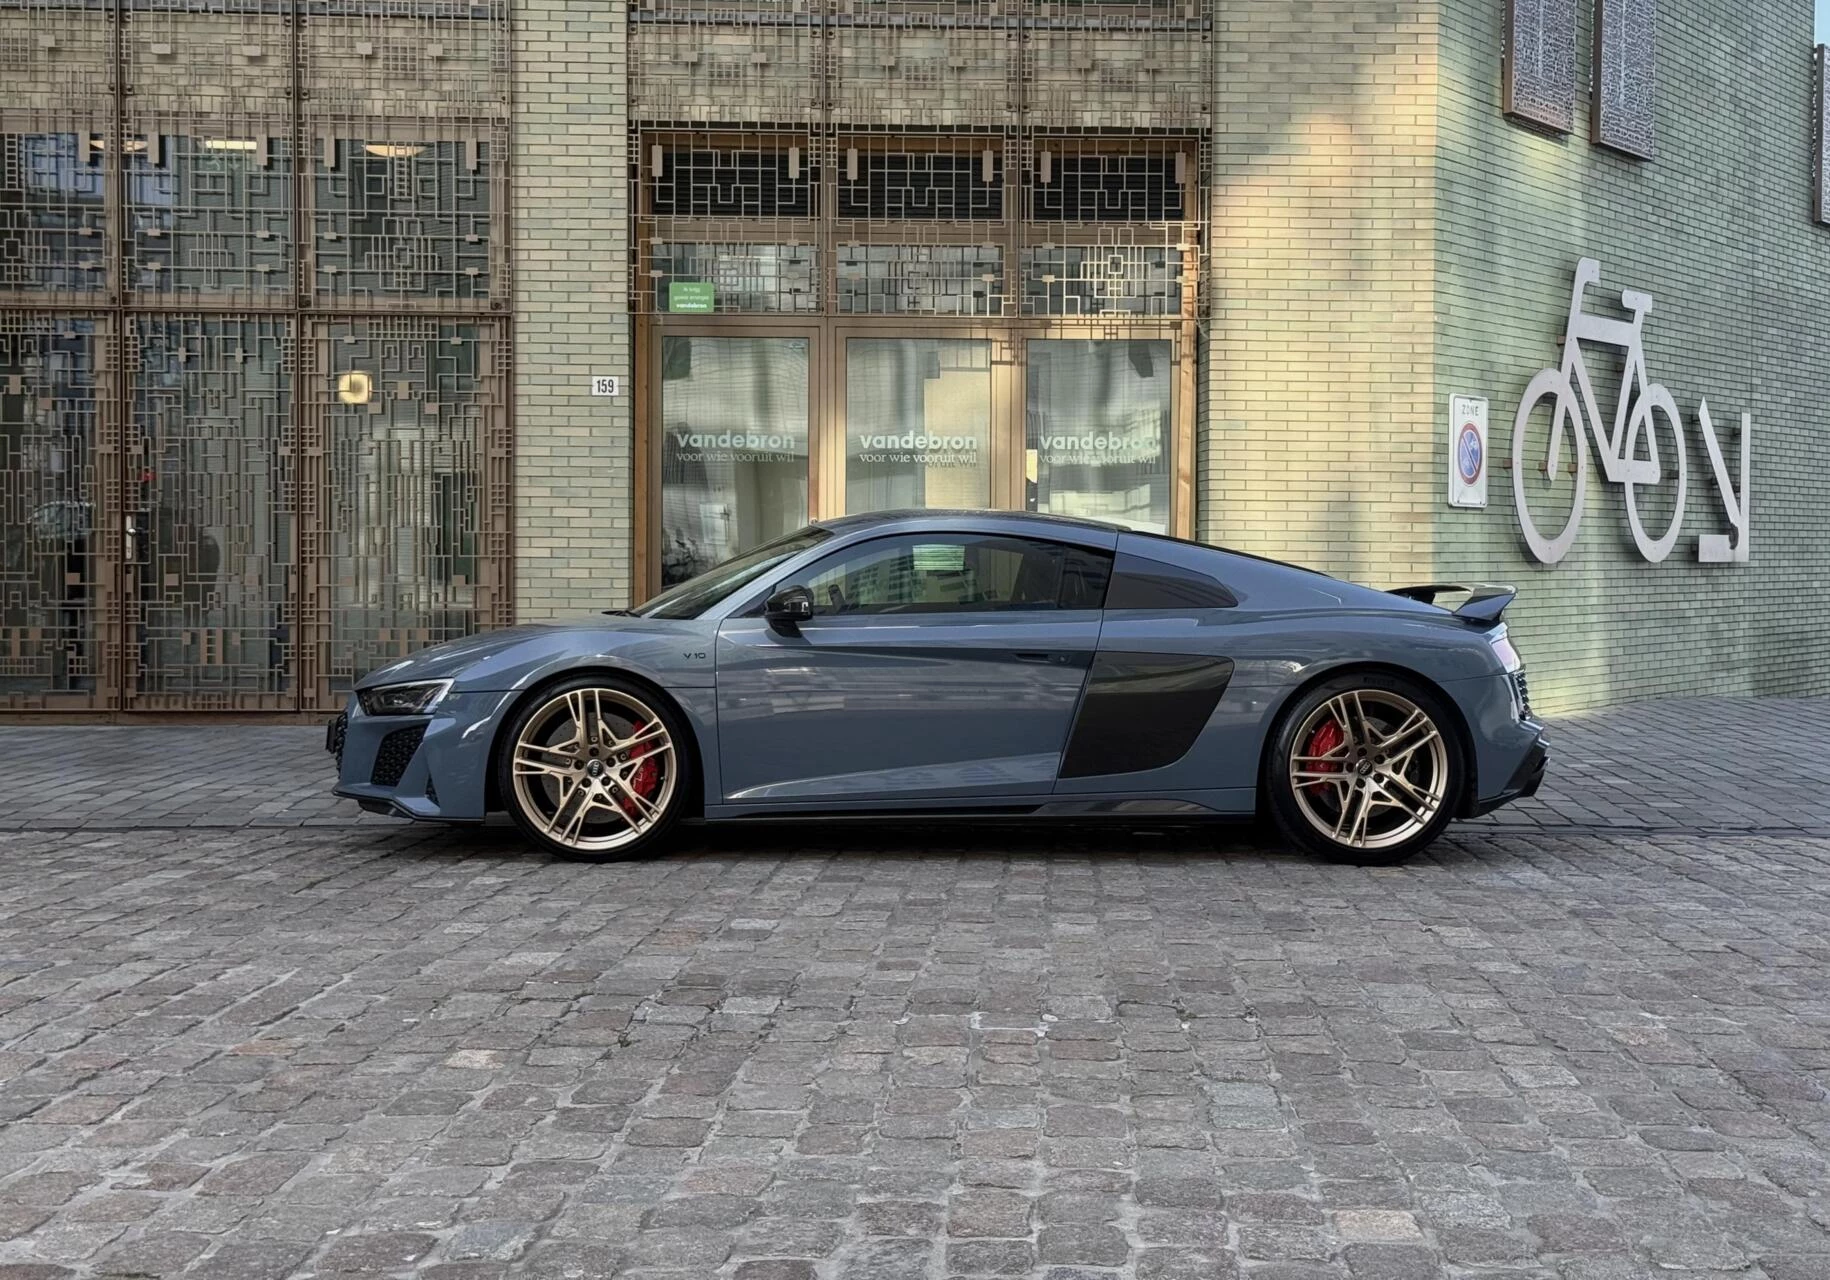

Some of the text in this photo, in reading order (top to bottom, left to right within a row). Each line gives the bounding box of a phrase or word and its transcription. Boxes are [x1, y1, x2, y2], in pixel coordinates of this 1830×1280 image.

[596, 379, 614, 393] 159
[1462, 404, 1479, 416] ZONE
[677, 430, 795, 448] vandebron
[859, 430, 977, 449] vandebron
[1041, 431, 1156, 450] vandebron
[677, 451, 795, 462] voor wie vooruit wil
[859, 452, 977, 464] voor wie vooruit wil
[1040, 455, 1066, 463] voor
